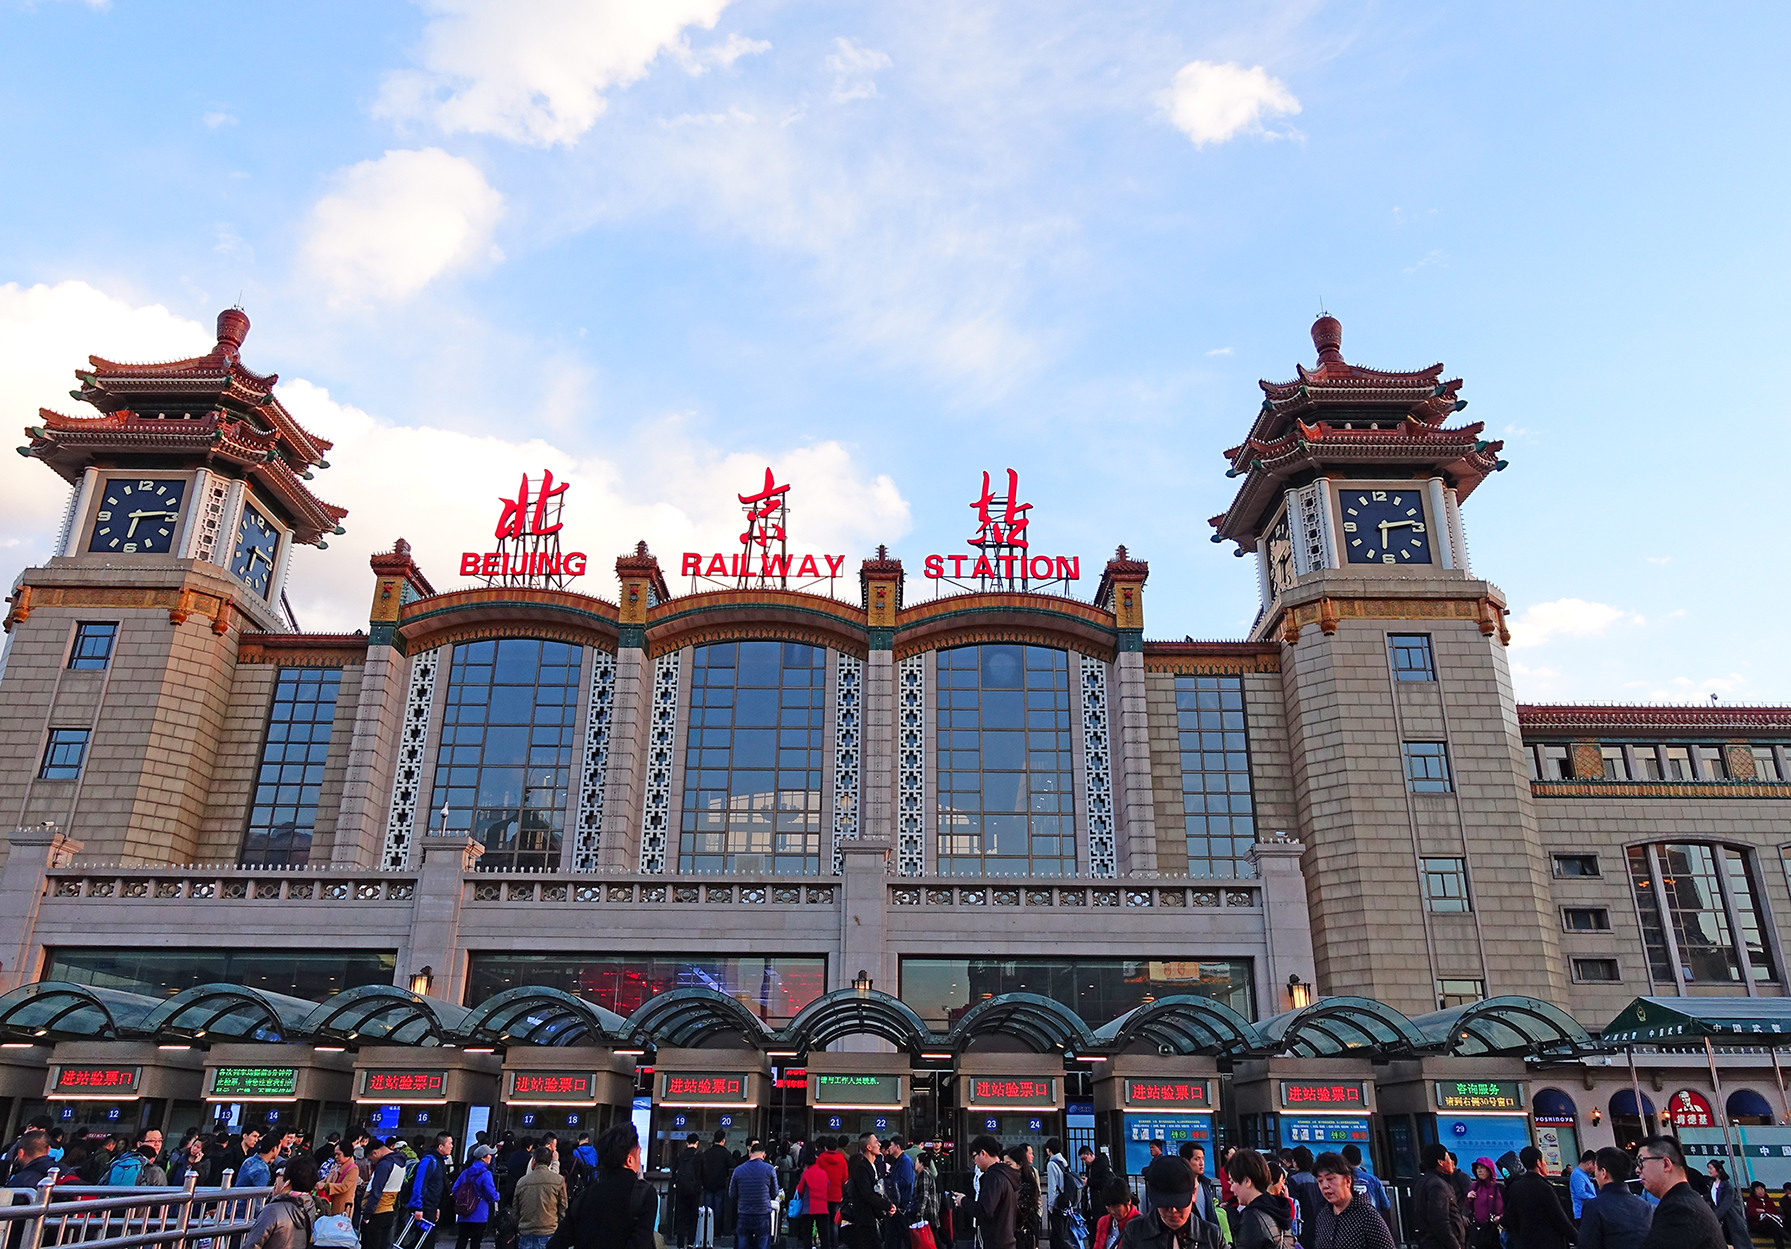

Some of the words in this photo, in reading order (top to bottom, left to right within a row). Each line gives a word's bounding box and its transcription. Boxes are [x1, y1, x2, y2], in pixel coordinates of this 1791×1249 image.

[138, 480, 154, 491] 12
[1372, 491, 1387, 501] 12
[98, 511, 112, 521] 9
[164, 512, 178, 522] 3
[256, 515, 265, 530] 12
[1343, 522, 1357, 532] 9
[1411, 522, 1426, 533] 3
[123, 543, 138, 553] 6
[1382, 554, 1397, 564] 6
[460, 551, 587, 576] BEIJING
[682, 553, 845, 578] RAILWAY
[924, 555, 1080, 580] STATION
[245, 575, 252, 587] 6
[1713, 1023, 1782, 1033] 中国武警
[369, 1074, 442, 1090] 进站验票口
[515, 1076, 587, 1092] 进站验票口
[668, 1078, 740, 1094] 进站验票口
[976, 1082, 1048, 1097] 进站验票口
[1131, 1084, 1203, 1100] 进站验票口
[1288, 1086, 1359, 1101] 进站验票口
[1456, 1083, 1500, 1095] 咨询服务
[1445, 1096, 1515, 1107] 请到右侧30号窗口
[63, 1109, 72, 1118] 11
[109, 1109, 119, 1118] 12
[221, 1111, 231, 1119] 13
[269, 1111, 279, 1120] 14
[372, 1113, 382, 1122] 15
[418, 1113, 428, 1122] 16
[524, 1115, 534, 1123] 17
[568, 1115, 578, 1124] 18
[676, 1117, 686, 1126] 19
[721, 1117, 732, 1126] 20
[830, 1118, 840, 1127] 21
[876, 1118, 886, 1127] 22
[986, 1120, 997, 1128] 23
[1676, 1114, 1708, 1125] 肯德基
[1030, 1120, 1041, 1129] 24
[1455, 1125, 1465, 1134] 29
